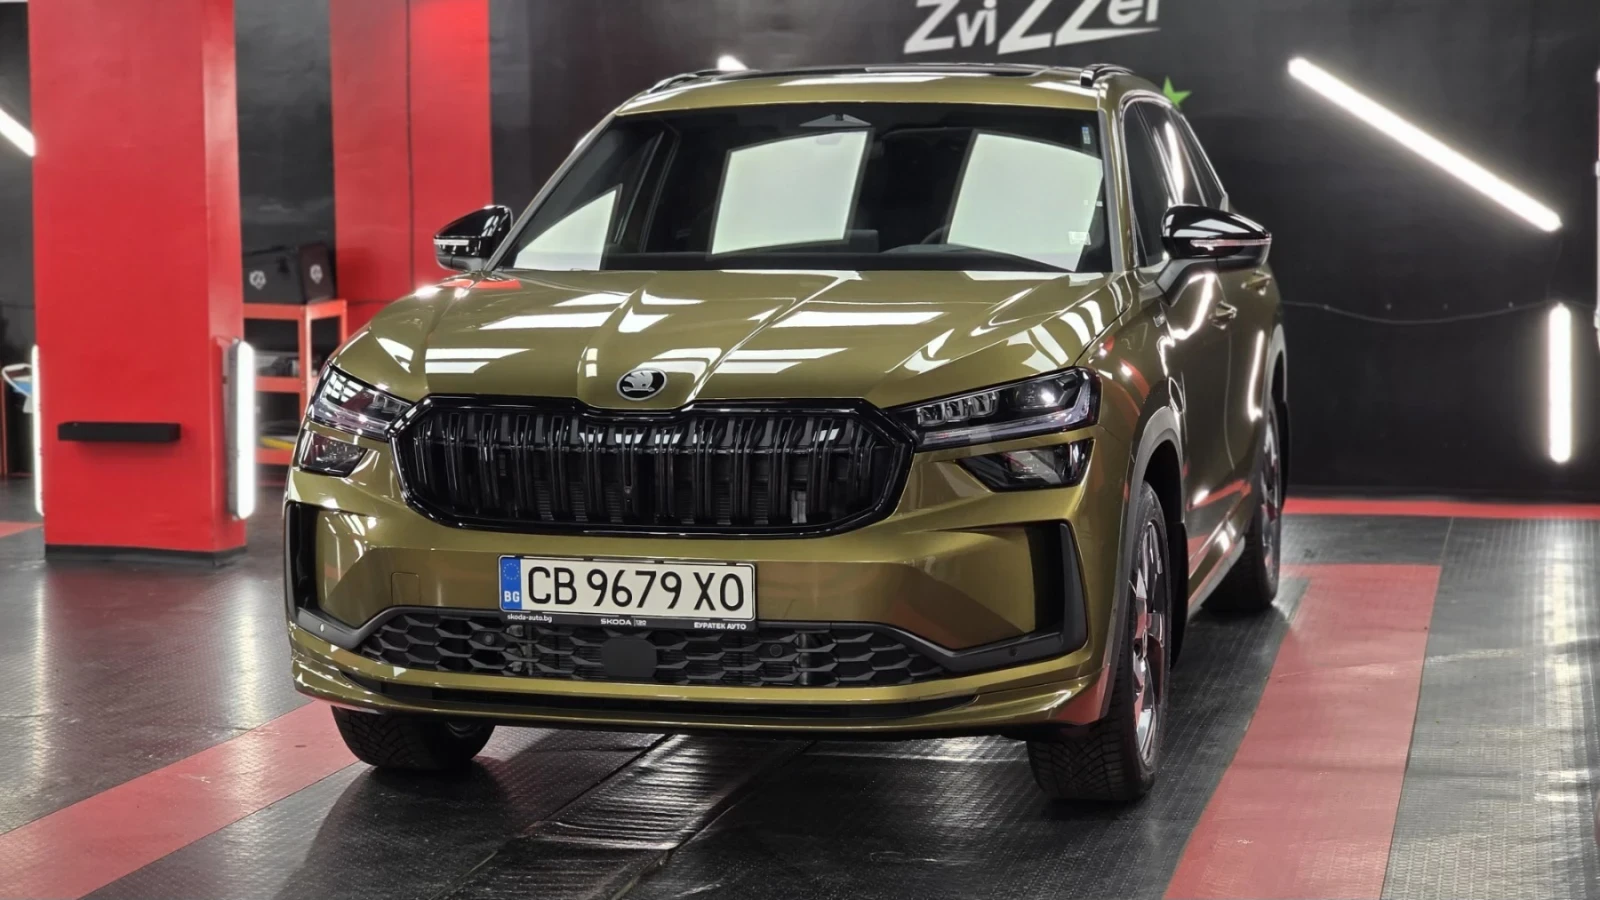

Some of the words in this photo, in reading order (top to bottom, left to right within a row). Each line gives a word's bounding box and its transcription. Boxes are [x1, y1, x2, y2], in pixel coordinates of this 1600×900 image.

[528, 566, 577, 605] CB
[586, 569, 682, 609] 9679
[503, 590, 520, 603] BG
[507, 613, 553, 623] skoda-auto.bg
